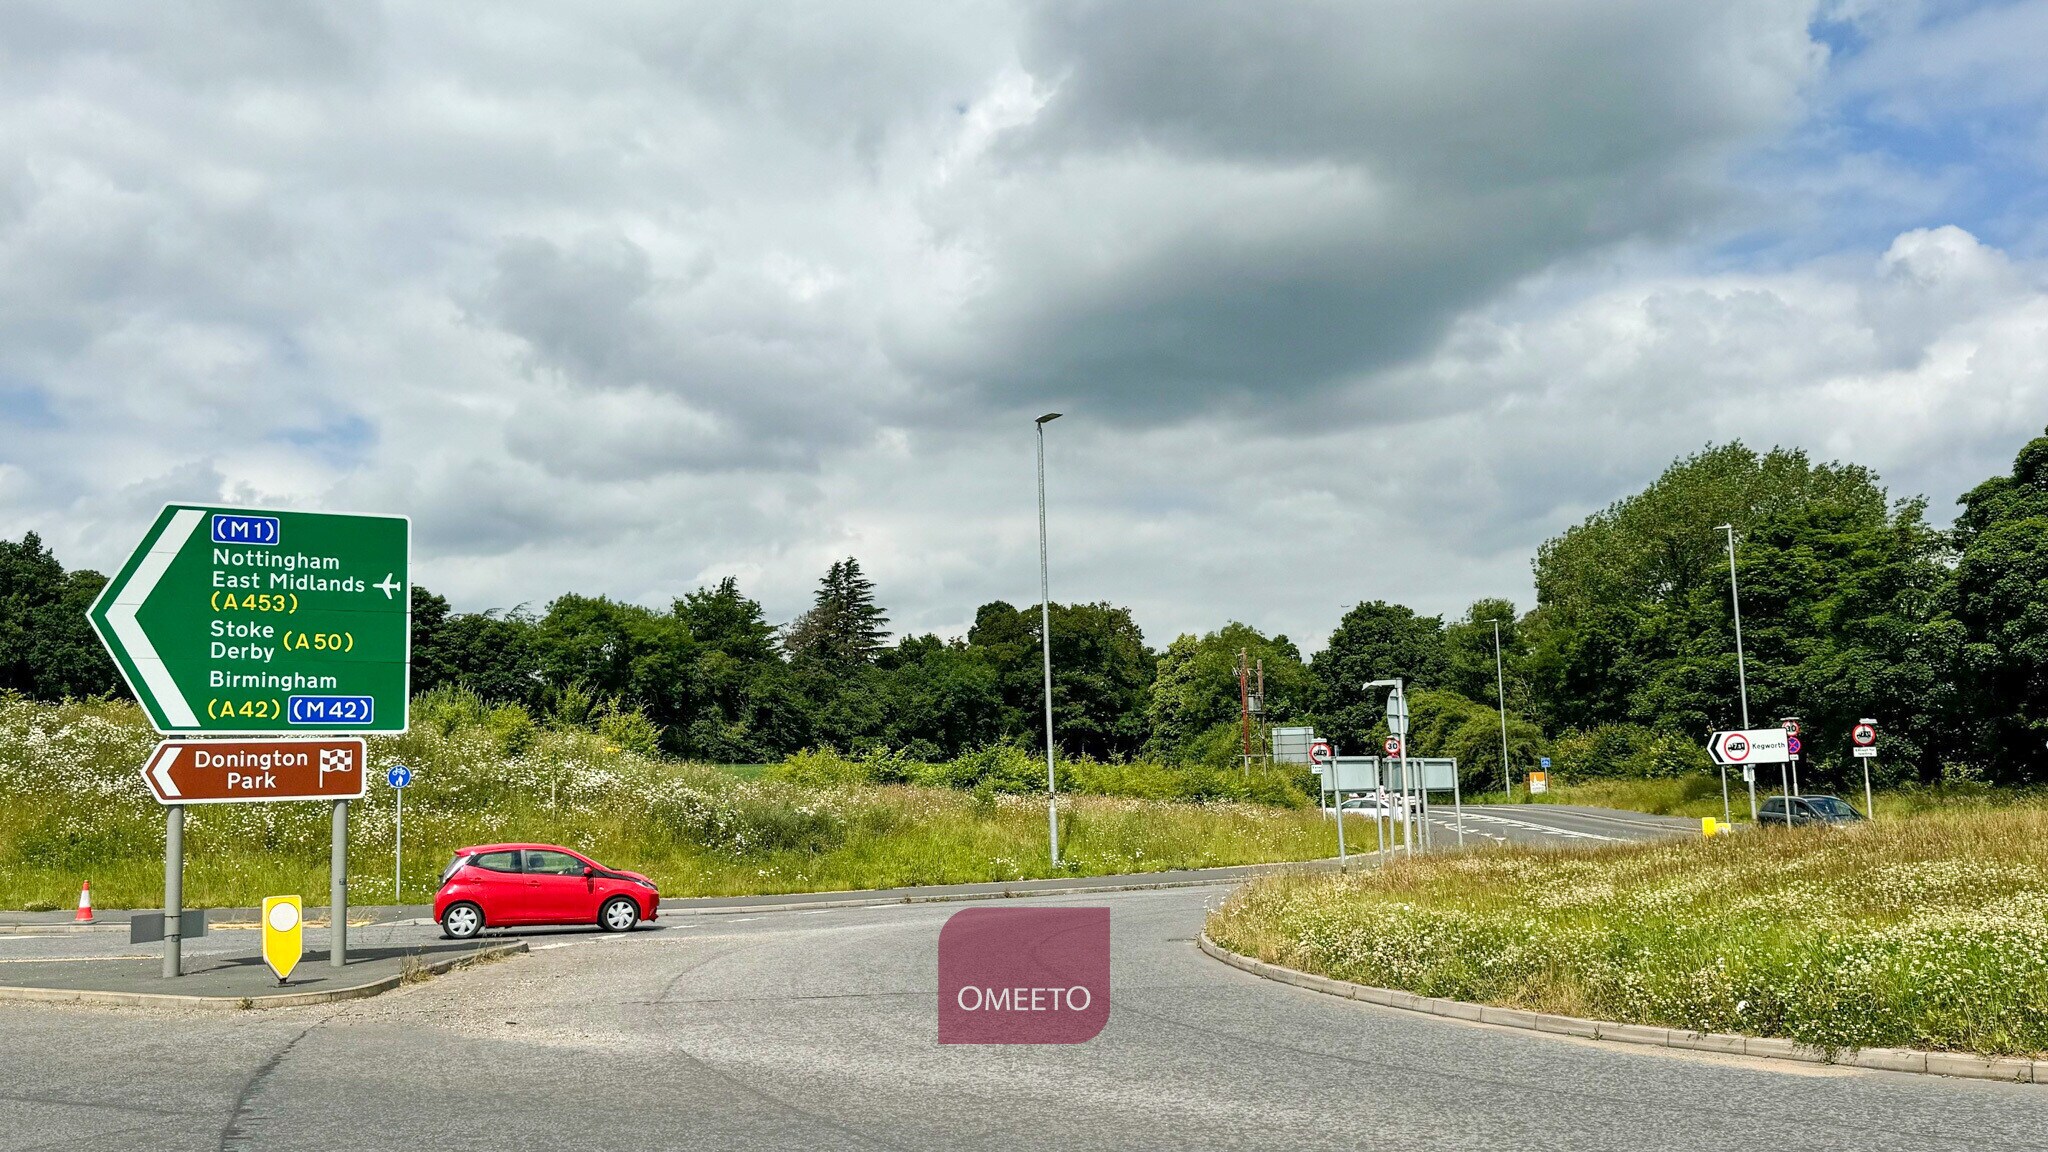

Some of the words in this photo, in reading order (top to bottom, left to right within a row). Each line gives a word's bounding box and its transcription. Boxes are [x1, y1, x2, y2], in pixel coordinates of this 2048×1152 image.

[217, 518, 275, 541] (M1)
[213, 548, 340, 571] Nottingham
[212, 571, 260, 589] East
[270, 573, 365, 592] Midlands
[210, 590, 298, 614] (A453)
[210, 620, 275, 638] Stoke
[210, 642, 275, 663] Derby
[209, 670, 337, 691] Birmingham
[207, 698, 281, 720] (A42)
[293, 699, 369, 720] (M42)
[1387, 742, 1398, 750] 30
[1752, 742, 1786, 751] Kegworth
[195, 750, 308, 770] Donington
[227, 771, 276, 789] Park
